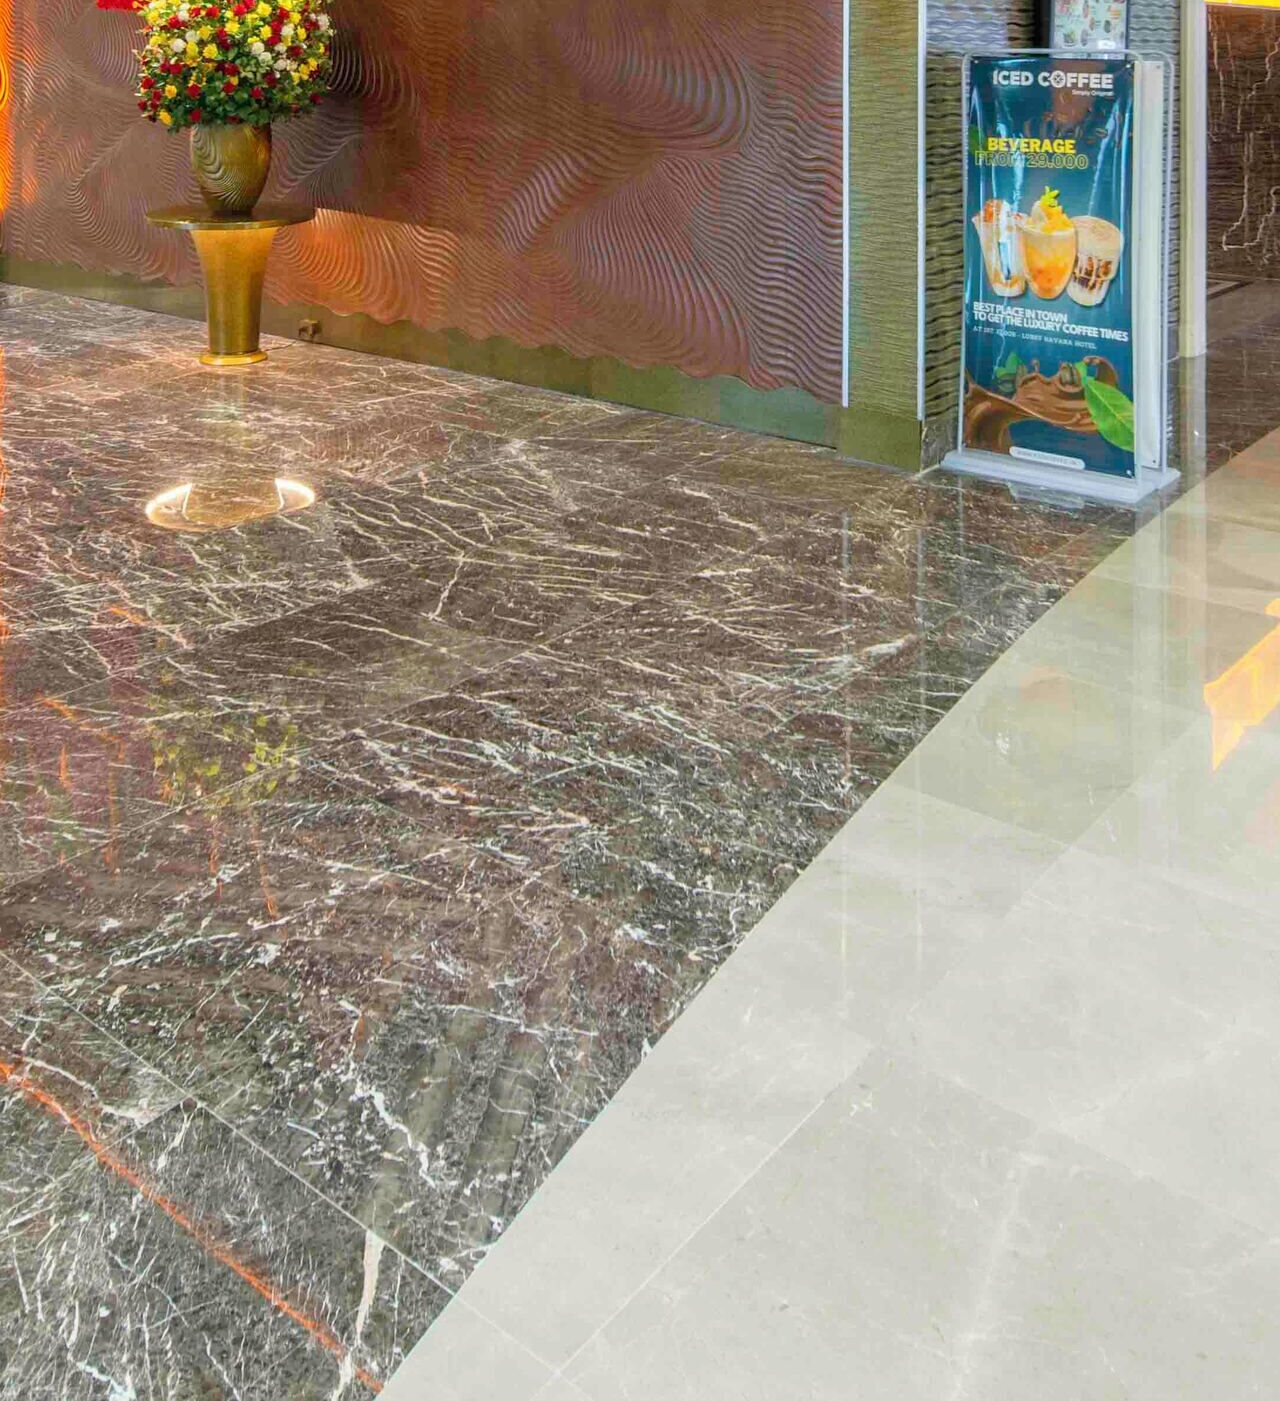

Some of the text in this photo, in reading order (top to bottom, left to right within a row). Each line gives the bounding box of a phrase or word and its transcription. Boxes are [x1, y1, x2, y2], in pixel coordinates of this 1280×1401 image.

[993, 70, 1114, 89] ICED COFFEE
[987, 137, 1076, 154] BEVERAGE
[974, 150, 1089, 170] FROM 29.000
[973, 301, 1068, 323] BEST PLACE IN TOWN
[973, 310, 1129, 342] TO GET THE LUXURY COFFEE TIMES
